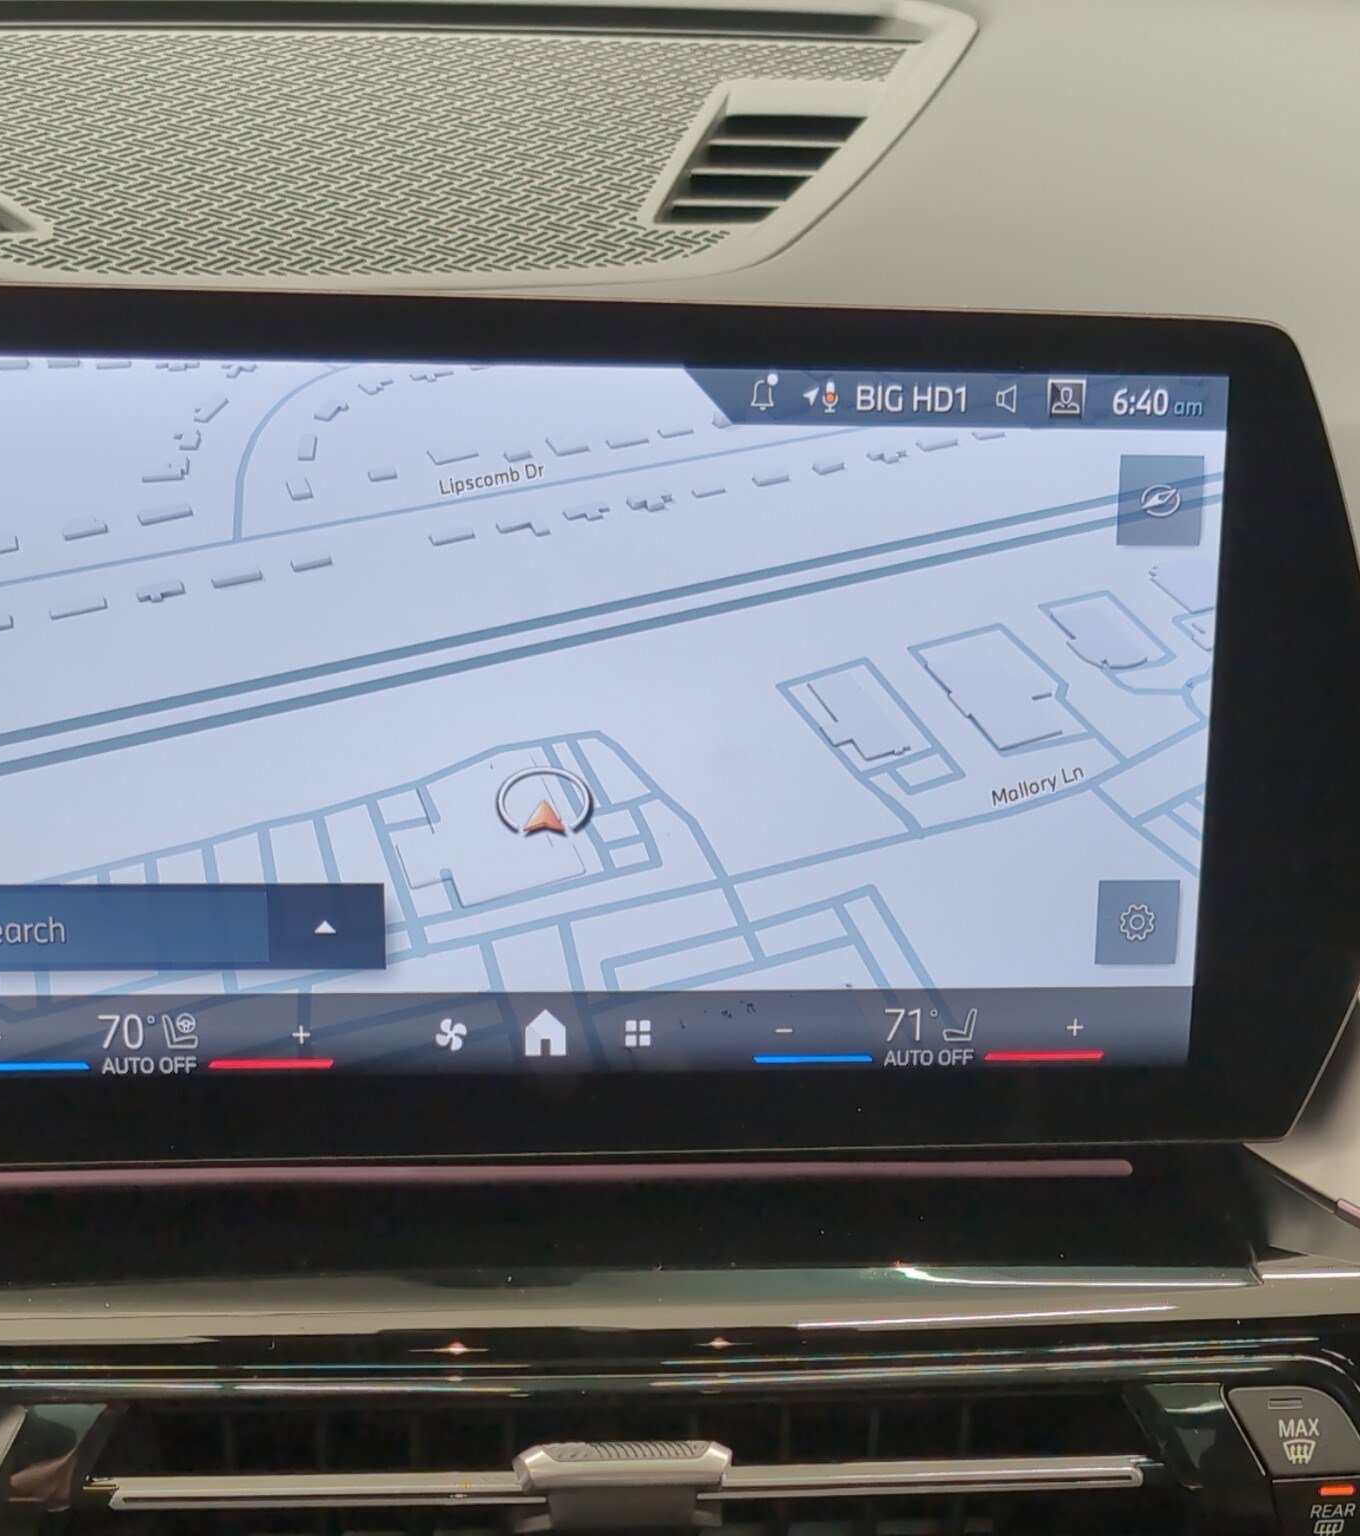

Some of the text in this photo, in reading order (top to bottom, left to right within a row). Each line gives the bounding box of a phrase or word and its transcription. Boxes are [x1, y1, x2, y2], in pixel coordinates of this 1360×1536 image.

[855, 384, 969, 414] BIG HD1
[1111, 387, 1204, 418] 6:40 am
[439, 463, 545, 497] Lipscomb Dr
[991, 763, 1086, 807] Mallory Ln
[101, 1056, 198, 1076] AUTO OFF
[883, 1048, 975, 1068] AUTO OFF
[1277, 1417, 1321, 1438] MAX
[1309, 1502, 1357, 1519] REAR
